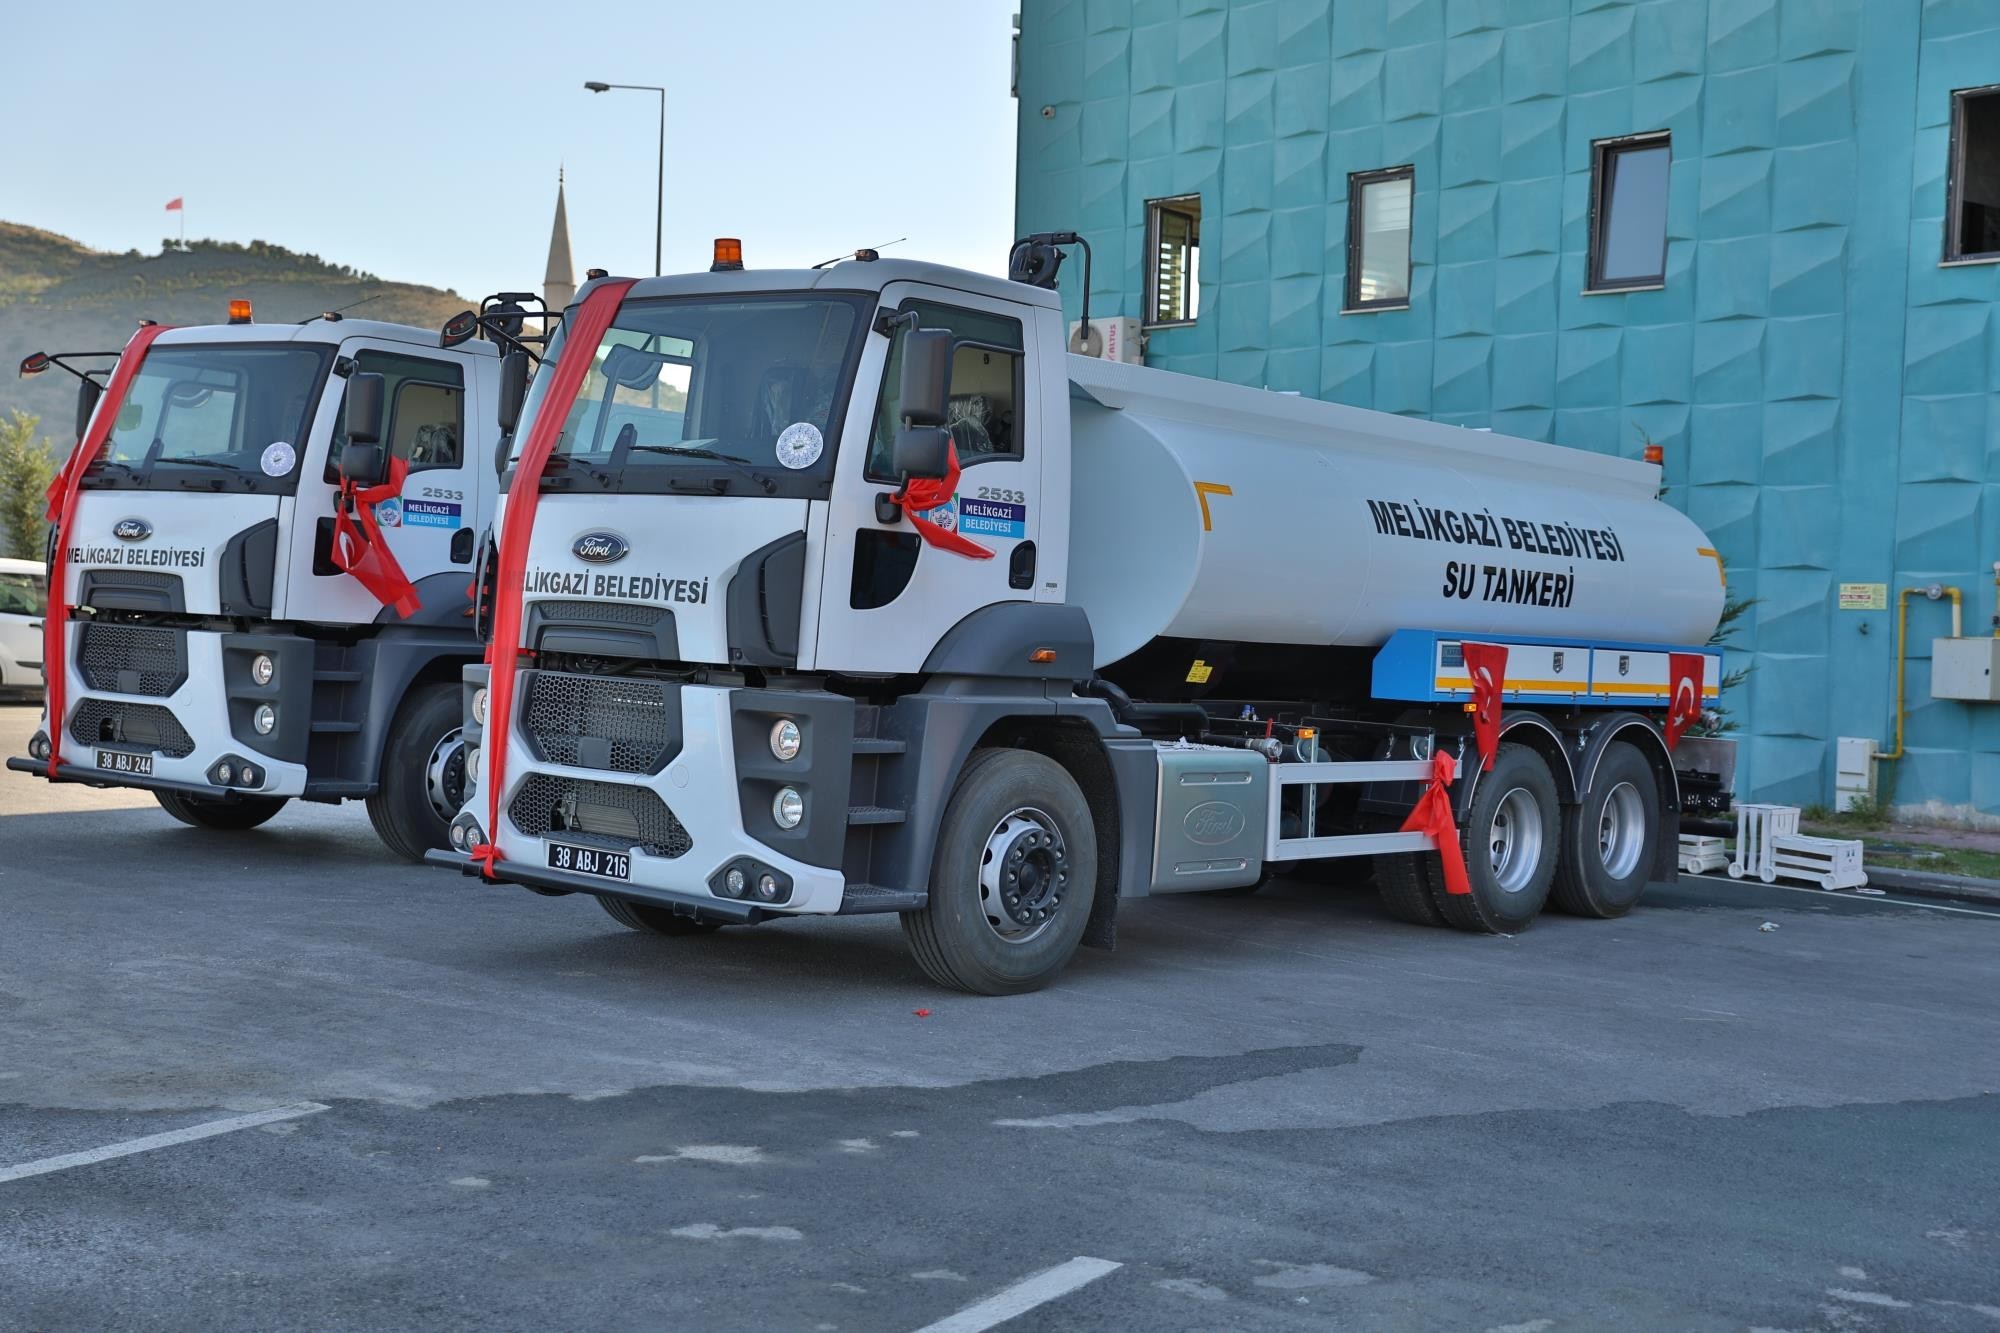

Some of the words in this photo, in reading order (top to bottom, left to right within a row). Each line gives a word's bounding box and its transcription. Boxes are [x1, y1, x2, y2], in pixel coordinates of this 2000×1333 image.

[422, 487, 464, 501] 2533
[977, 486, 1025, 504] 2533
[408, 503, 449, 514] MELİKGAZİ
[965, 504, 1013, 519] MELİKGAZİ
[408, 514, 449, 525] BELEDİYESİ
[965, 518, 1011, 533] BELEDİYESİ
[117, 521, 141, 537] Ford
[1366, 498, 1503, 548] MELİKGAZİ
[1500, 517, 1625, 562] BELEDİYESİ
[66, 544, 125, 565] MELİKGAZİ
[127, 546, 205, 567] BELEDİYESİ
[580, 537, 612, 556] Ford
[511, 566, 590, 596] LİKGAZİ
[593, 572, 709, 605] BELEDİYESİ
[1442, 560, 1475, 600] SU
[1483, 565, 1575, 608] TANKERİ
[101, 752, 112, 769] 38
[115, 754, 132, 771] ABJ
[134, 756, 151, 774] 244
[555, 846, 571, 868] 38
[576, 850, 599, 872] ABJ
[605, 854, 628, 877] 216
